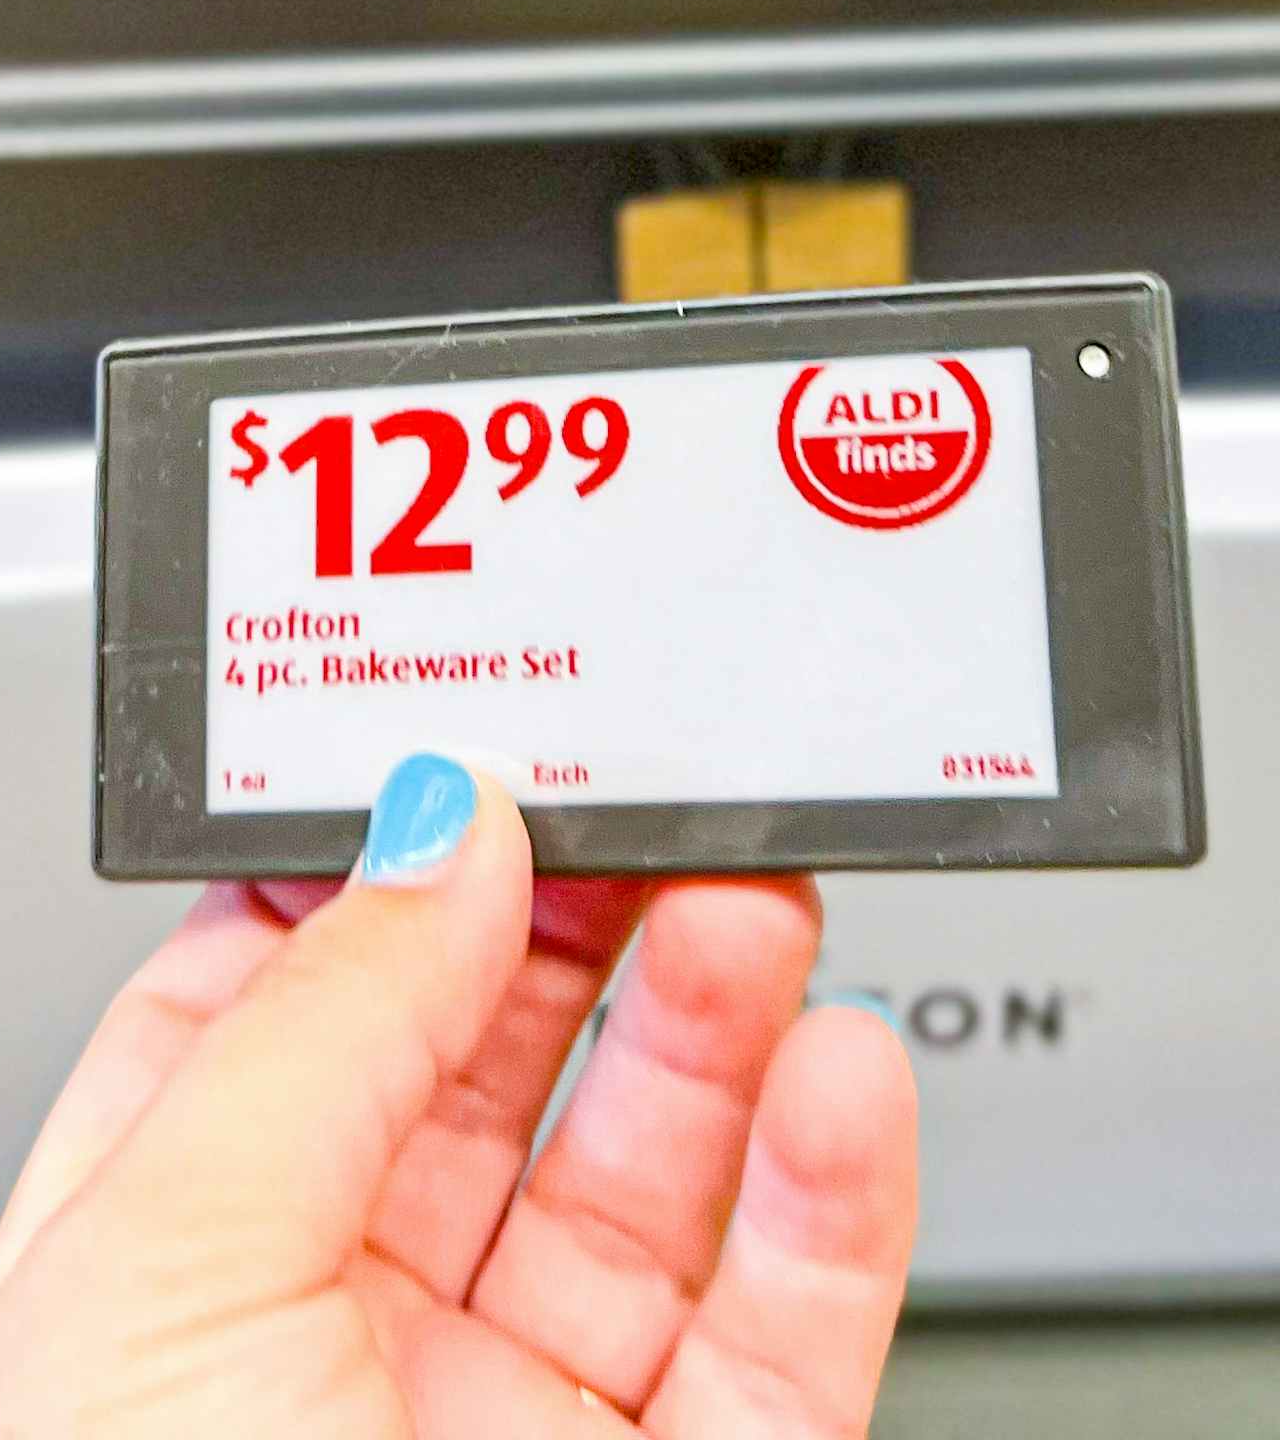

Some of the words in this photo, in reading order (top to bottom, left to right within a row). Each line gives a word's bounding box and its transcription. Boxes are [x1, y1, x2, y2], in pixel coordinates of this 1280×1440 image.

[825, 389, 940, 425] ALDI
[835, 434, 938, 474] finds
[225, 605, 361, 643] Crofton
[225, 656, 245, 687] 4
[256, 658, 308, 698] pc.
[321, 646, 508, 684] Bakeware
[521, 644, 581, 680] Set
[222, 769, 232, 793] 1
[240, 773, 267, 793] ea
[532, 761, 590, 786] Each
